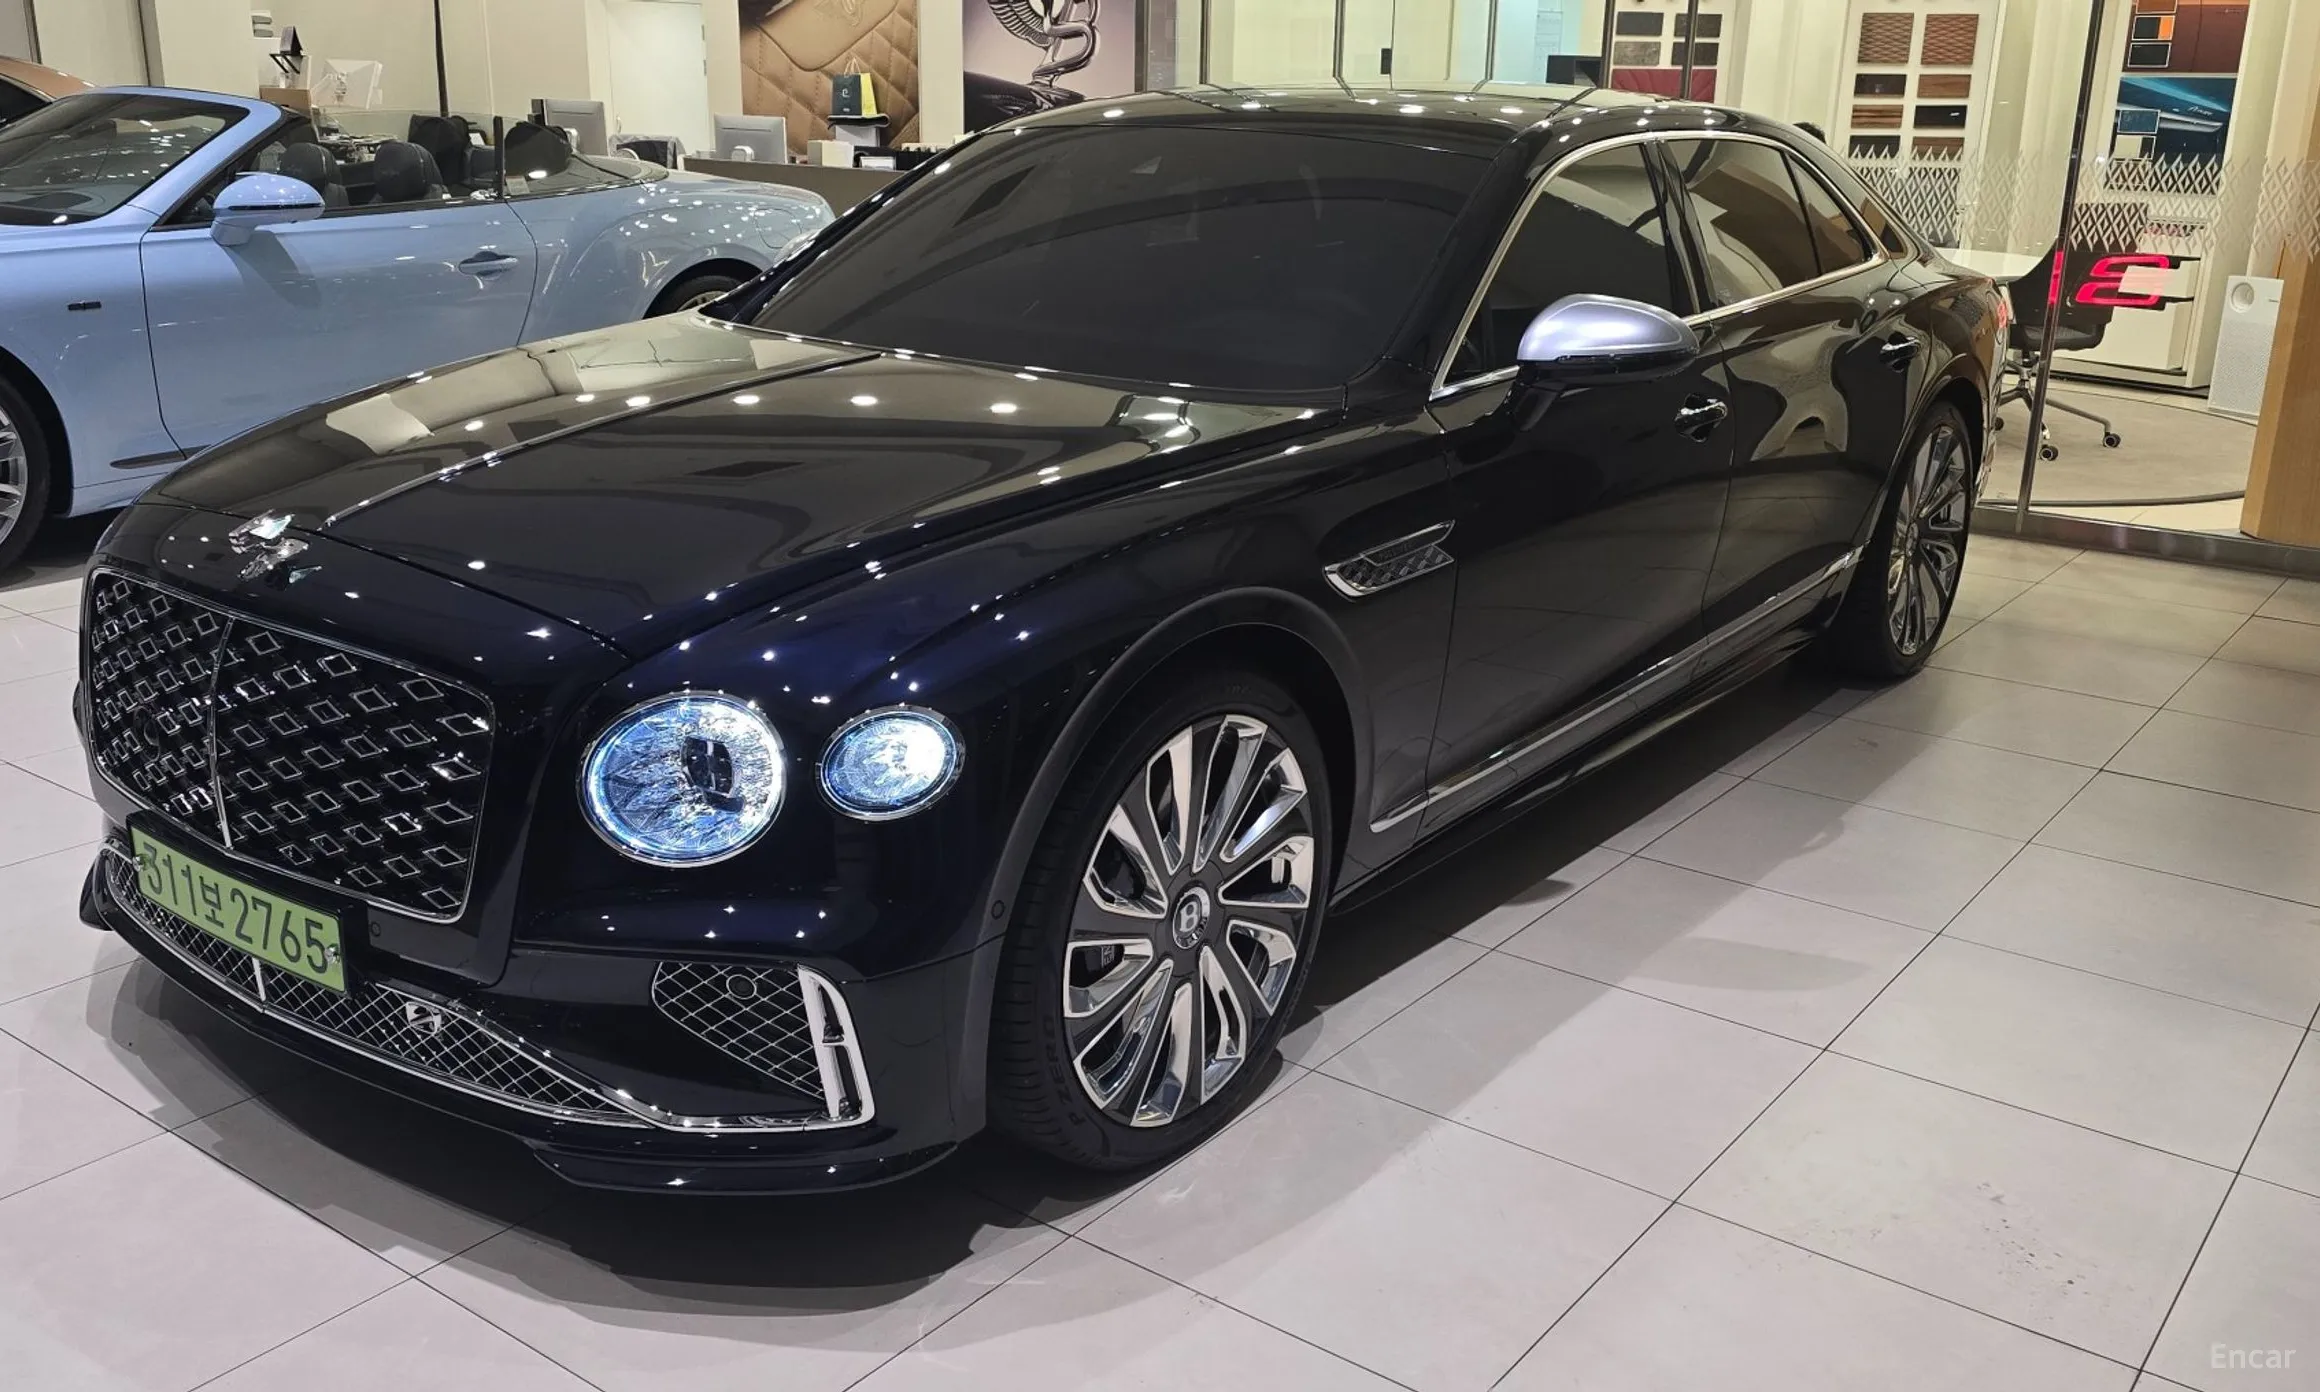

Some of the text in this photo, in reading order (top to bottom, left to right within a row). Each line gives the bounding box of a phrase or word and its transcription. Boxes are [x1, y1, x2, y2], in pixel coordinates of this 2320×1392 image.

[1179, 901, 1199, 933] B
[1043, 1015, 1087, 1126] P ZERO
